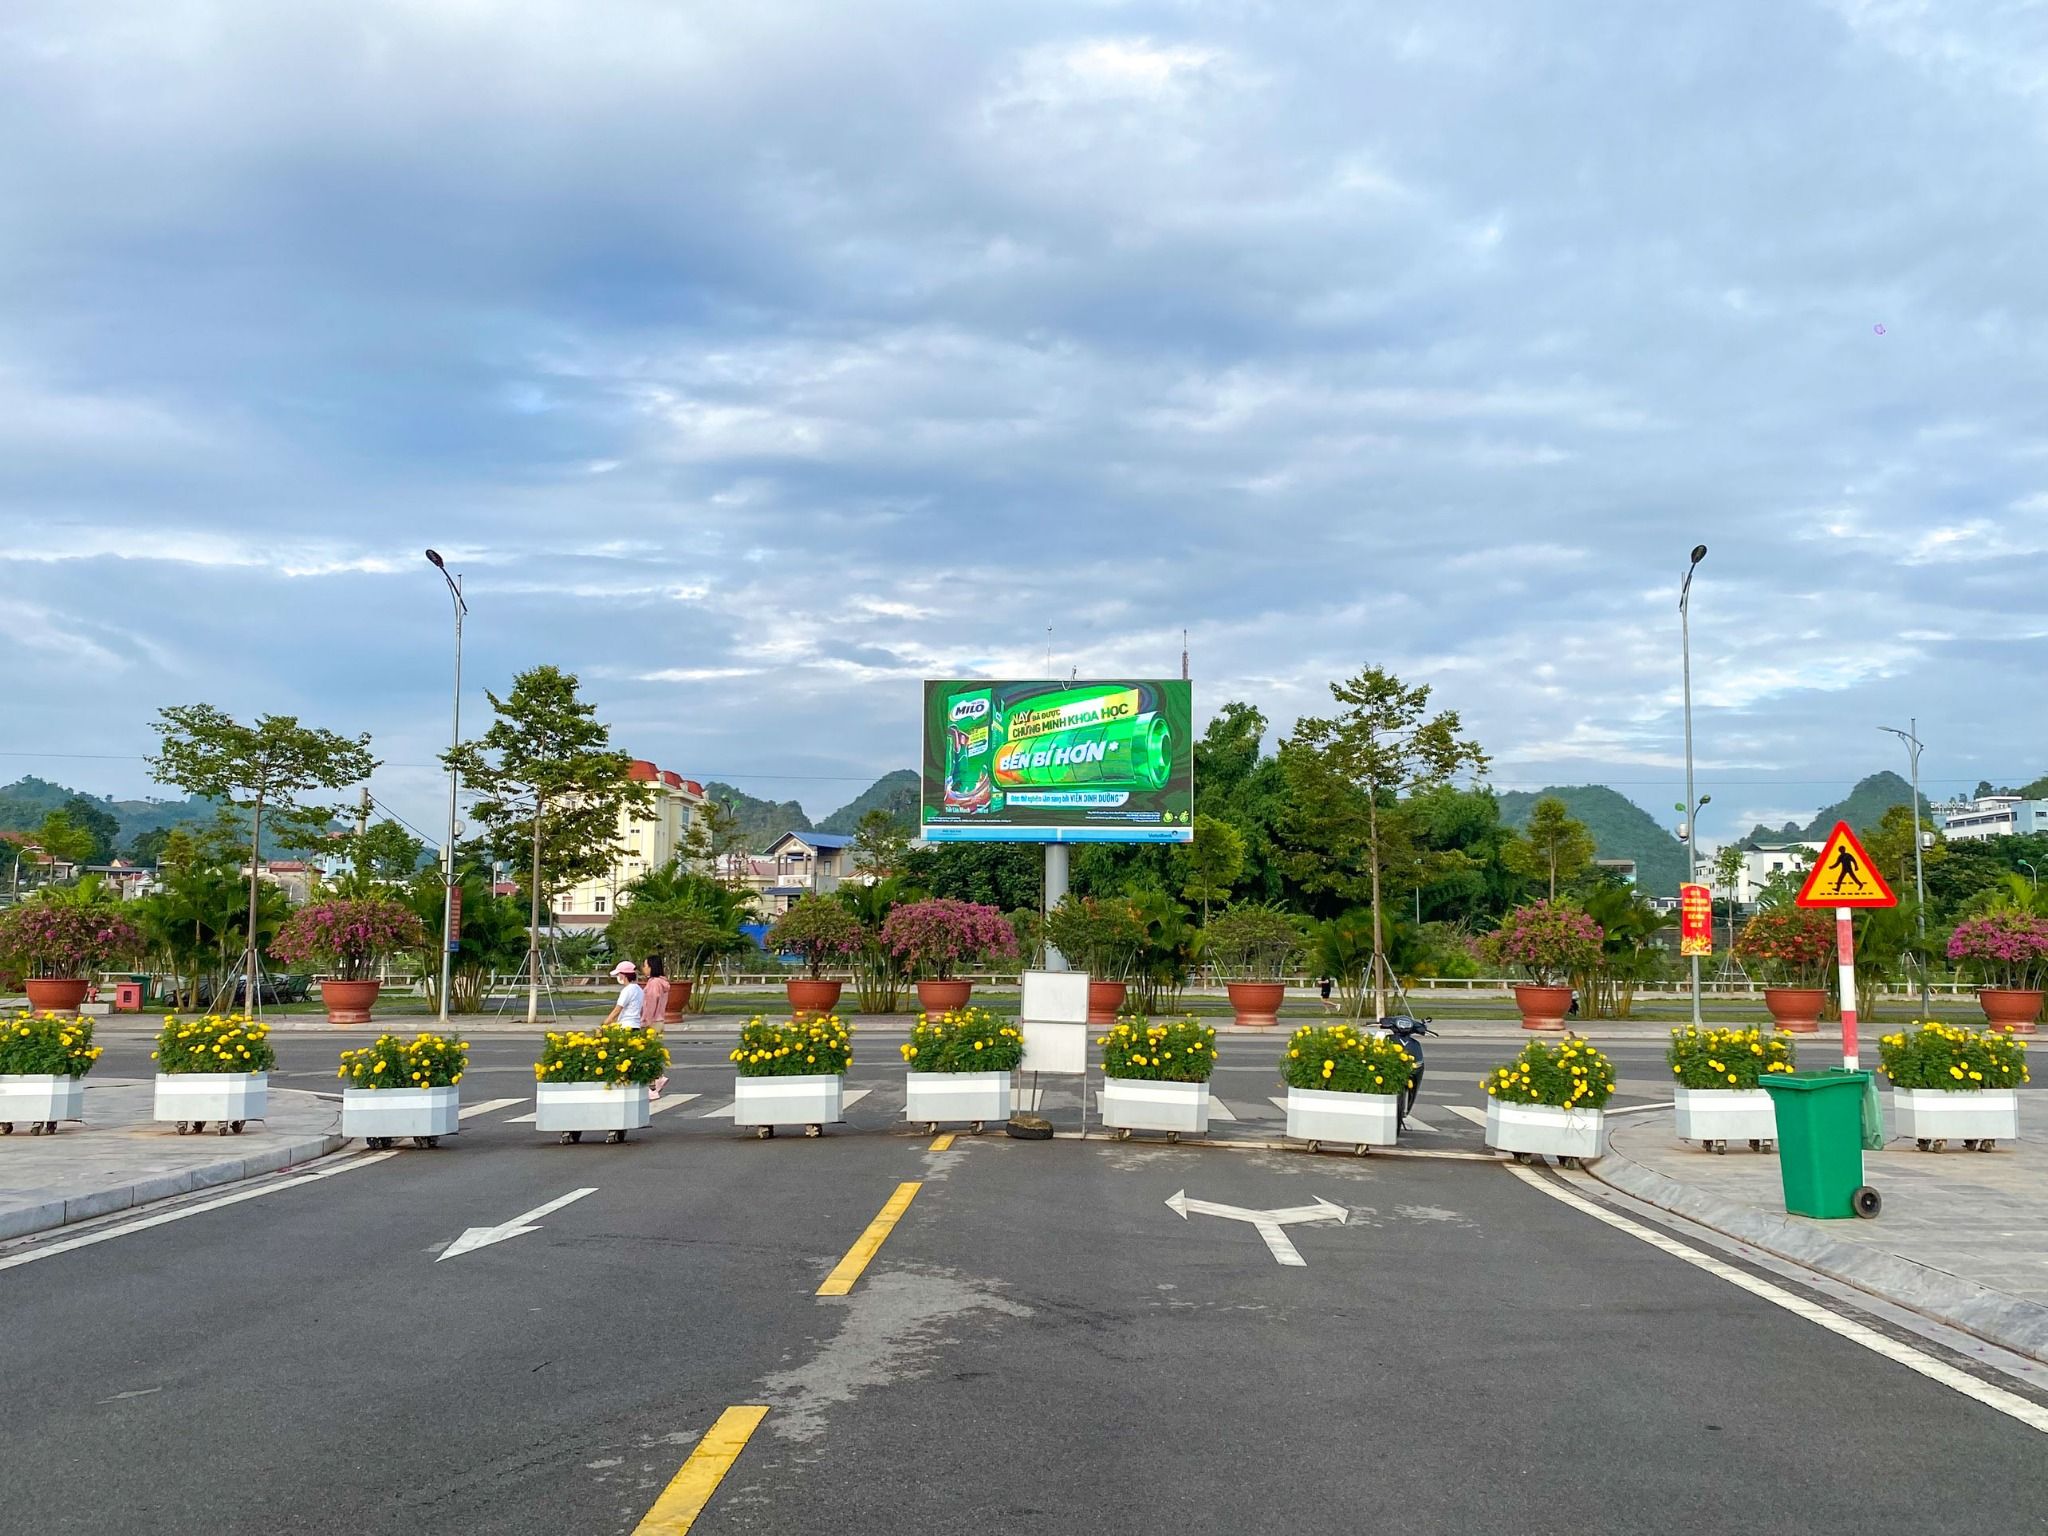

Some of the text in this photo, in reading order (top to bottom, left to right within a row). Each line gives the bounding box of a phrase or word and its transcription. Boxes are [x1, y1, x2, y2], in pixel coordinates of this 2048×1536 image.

[955, 704, 985, 717] MILO
[1011, 709, 1033, 726] NAY
[1042, 717, 1067, 732] MINH
[1068, 710, 1100, 726] KHOA
[1100, 703, 1129, 720] HỌC
